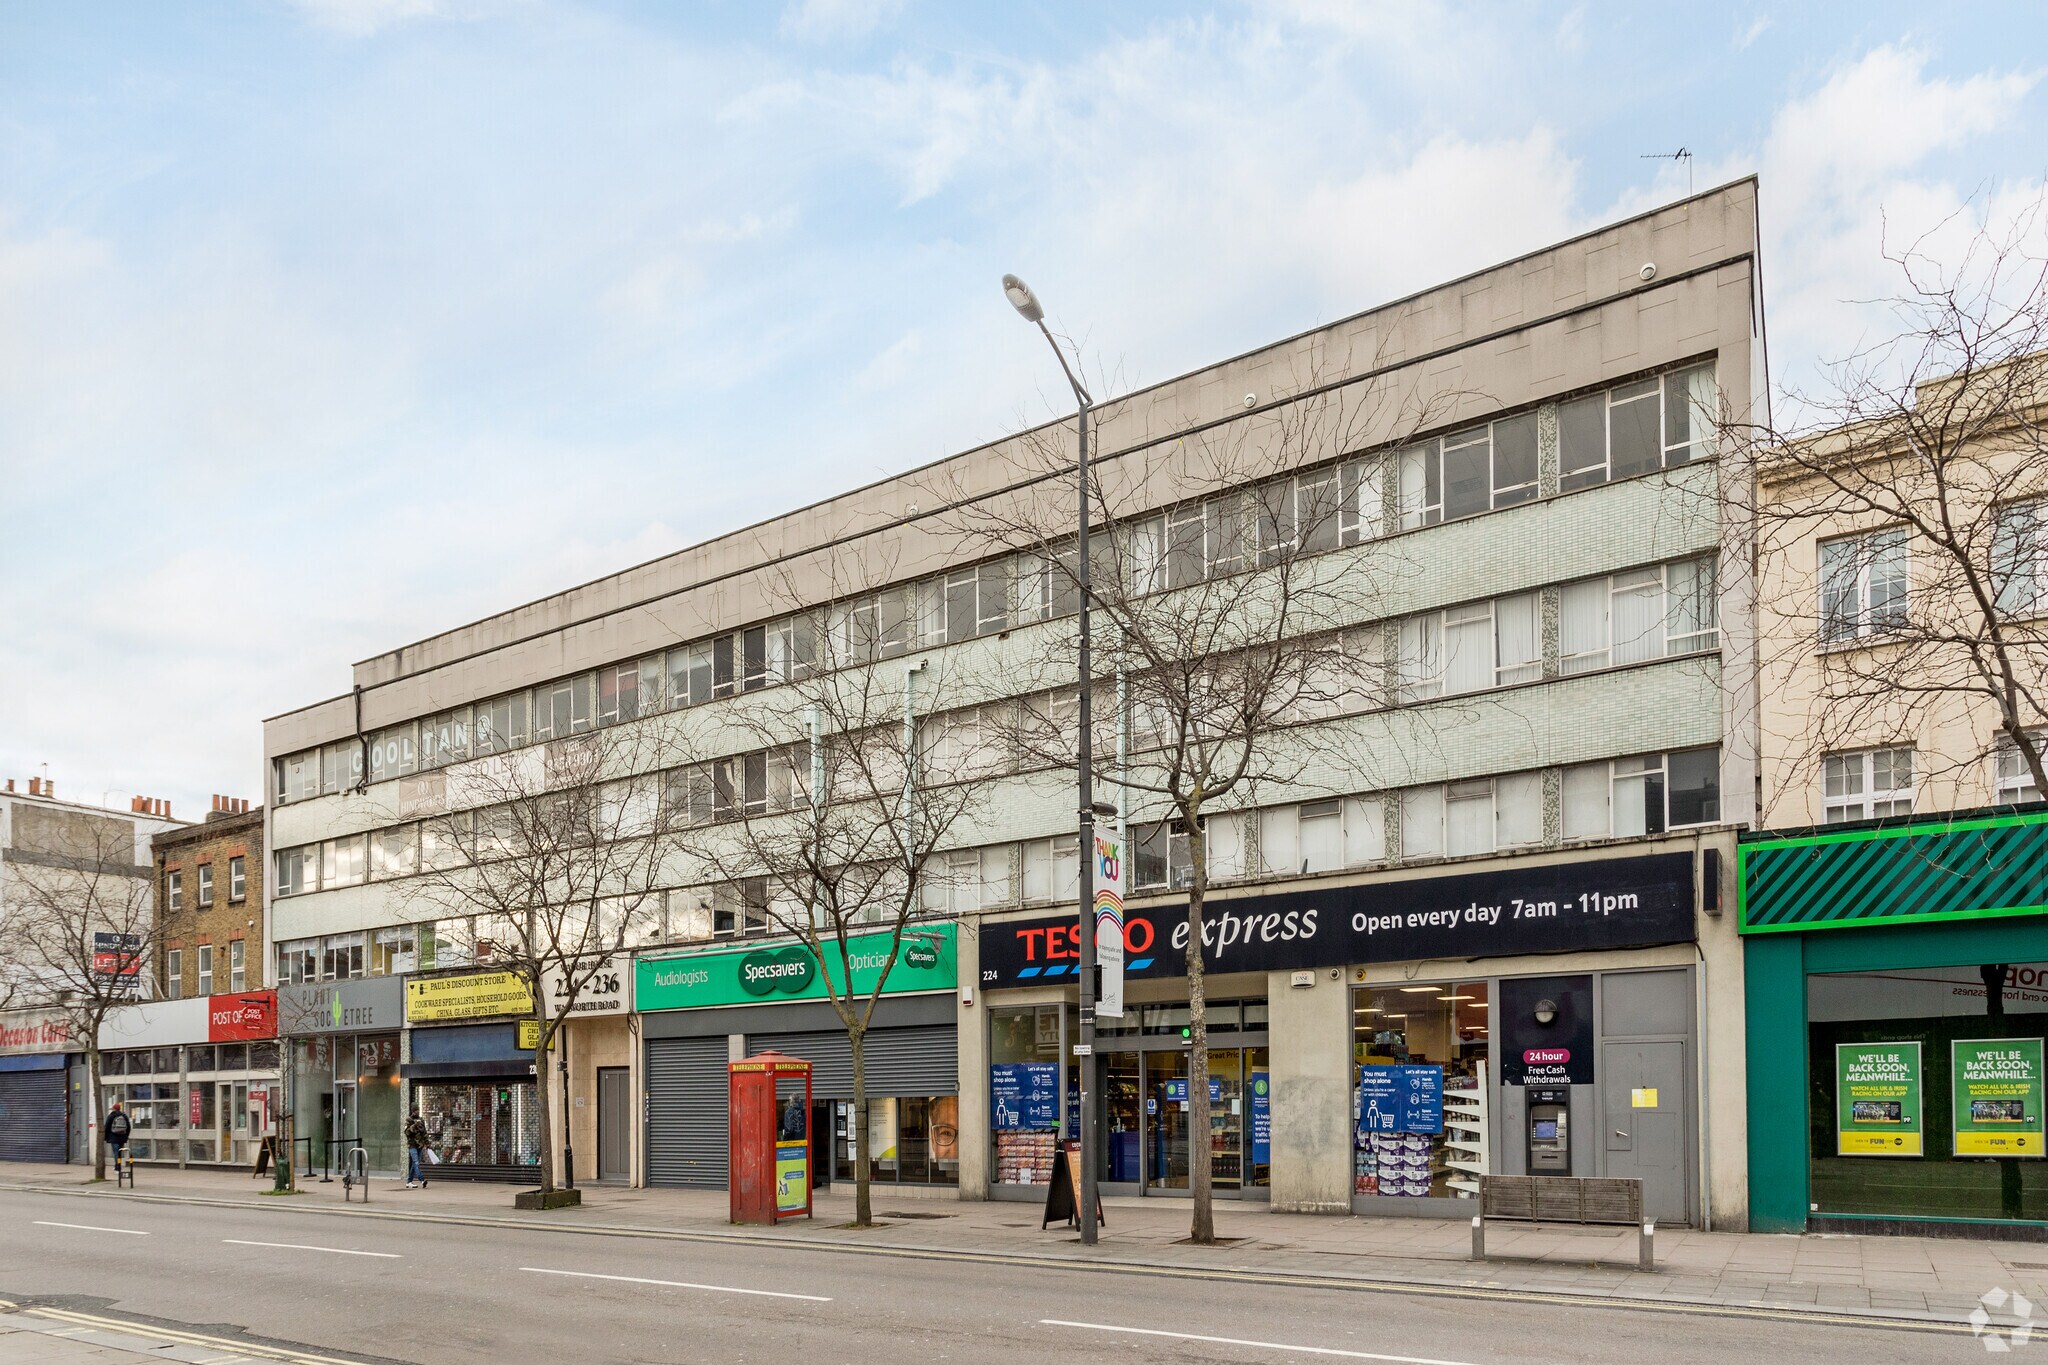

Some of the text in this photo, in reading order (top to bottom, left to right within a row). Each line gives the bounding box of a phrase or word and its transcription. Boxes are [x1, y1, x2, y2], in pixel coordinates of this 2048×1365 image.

[352, 738, 414, 773] COOL
[422, 724, 468, 755] TAN
[1096, 836, 1118, 860] THANK
[1097, 852, 1120, 882] YOU
[1352, 912, 1402, 934] Open
[1406, 908, 1460, 928] every
[1464, 902, 1502, 926] day
[1511, 899, 1556, 919] 7am
[1578, 892, 1638, 914] 11pm
[1016, 908, 1318, 961] TESO express
[910, 950, 935, 962] Specsavers
[744, 961, 806, 983] Specsavers
[982, 970, 998, 980] 224
[430, 975, 506, 990] PAUL'S DISCOUNT STORE
[592, 972, 620, 994] 236
[654, 970, 708, 987] Audiologists
[302, 988, 330, 1006] PLANT
[414, 999, 441, 1008] COOKWARE
[476, 992, 507, 1004] HOUSEHOLD
[508, 991, 526, 1000] GOODS
[472, 1006, 488, 1014] GIFTS
[554, 1000, 620, 1012] WAWORTH ROAD
[213, 1012, 231, 1025] POST
[1207, 1052, 1225, 1060] Great
[1529, 1052, 1563, 1061] 24 hour
[1858, 1054, 1899, 1062] WE'LL BE
[1976, 1051, 2021, 1060] WE'LL BE
[1528, 1066, 1565, 1074] Free Cash
[1849, 1063, 1910, 1072] BACK SOON,
[1966, 1061, 2032, 1070] BACK SOON,
[1523, 1075, 1571, 1084] Withdrawals
[1846, 1073, 1913, 1081] MEANWHILE...
[1963, 1070, 2036, 1080] MEANWHILE...
